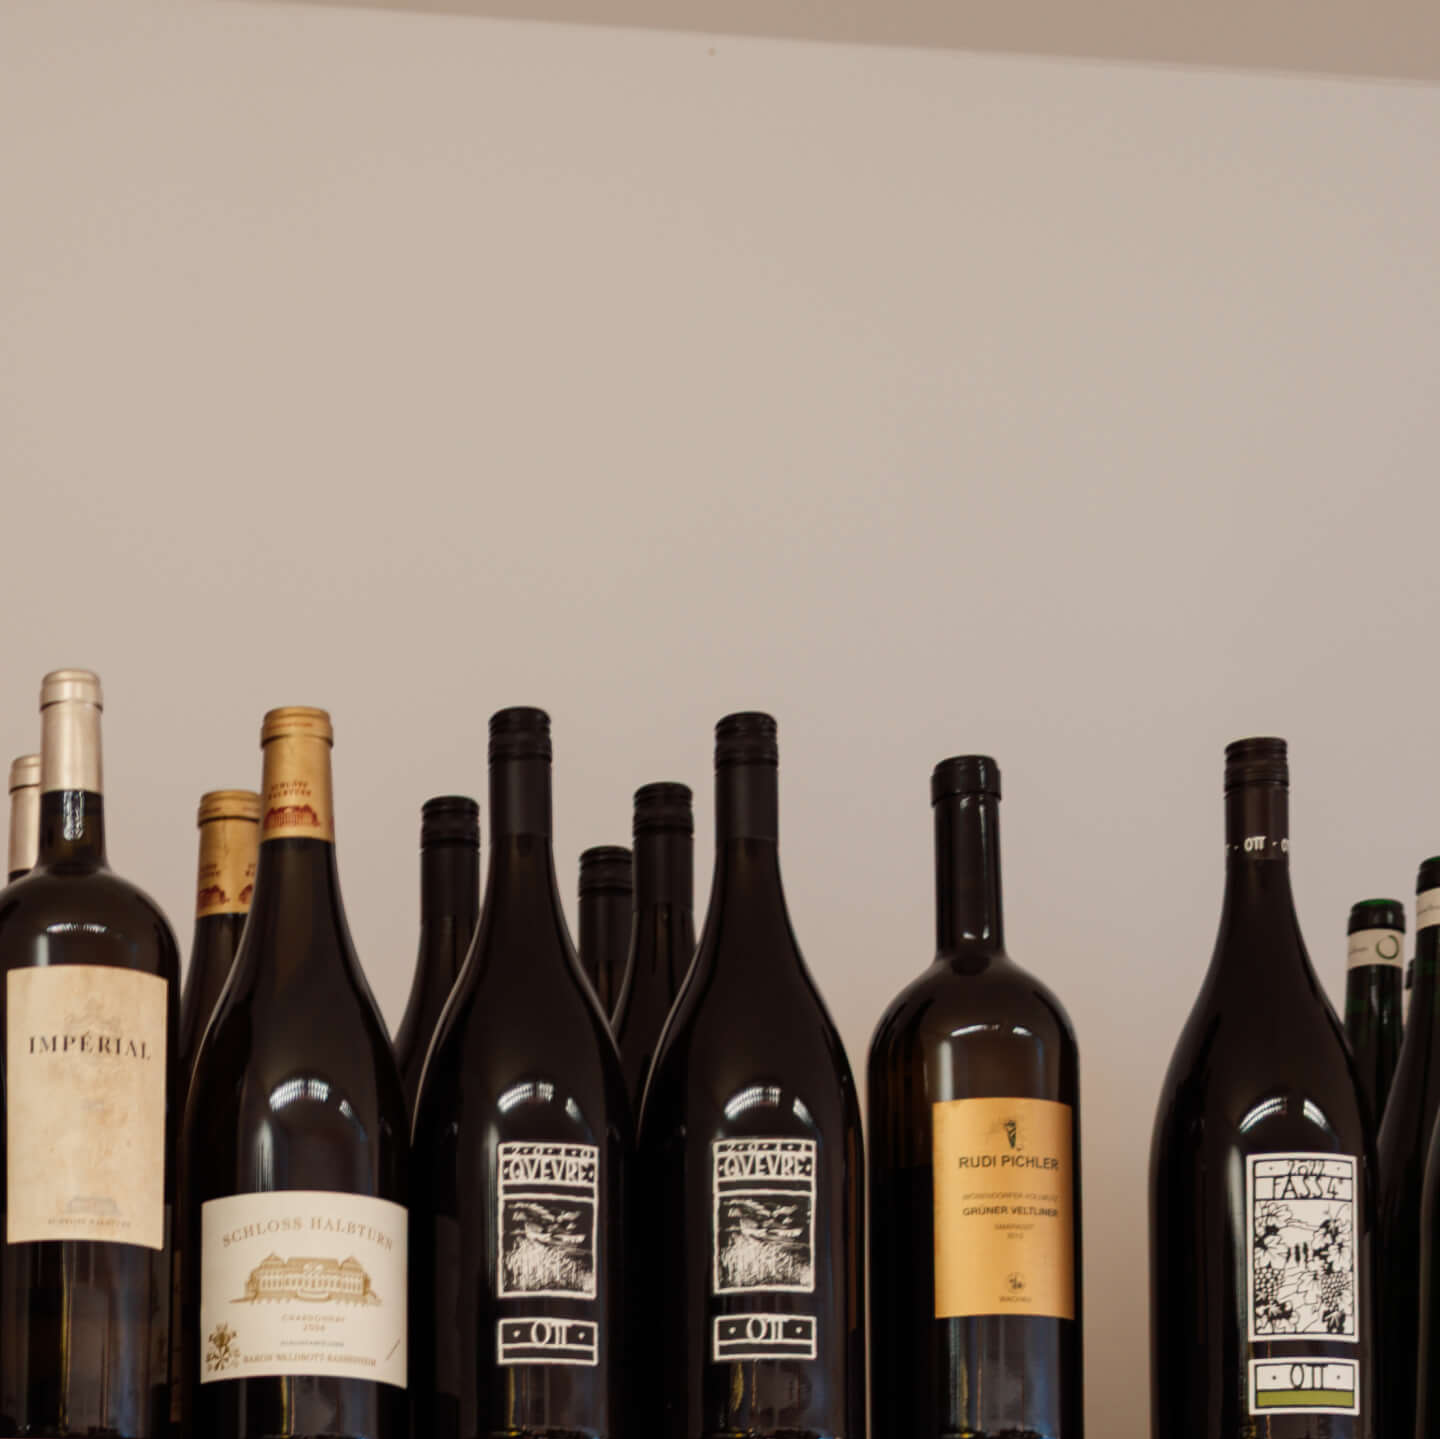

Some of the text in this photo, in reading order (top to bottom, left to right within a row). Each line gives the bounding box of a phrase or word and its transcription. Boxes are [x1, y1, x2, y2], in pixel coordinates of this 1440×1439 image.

[1244, 835, 1267, 852] OTT
[28, 1031, 152, 1060] IMPÉRIAL
[959, 1155, 1060, 1171] RUDI PICHLER
[962, 1206, 1059, 1218] GRÜNER VELTLINER
[222, 1216, 394, 1252] SCHLOSS HALBTURN
[531, 1319, 574, 1345] OTT
[746, 1316, 790, 1342] OTT
[1290, 1363, 1328, 1390] OTT
